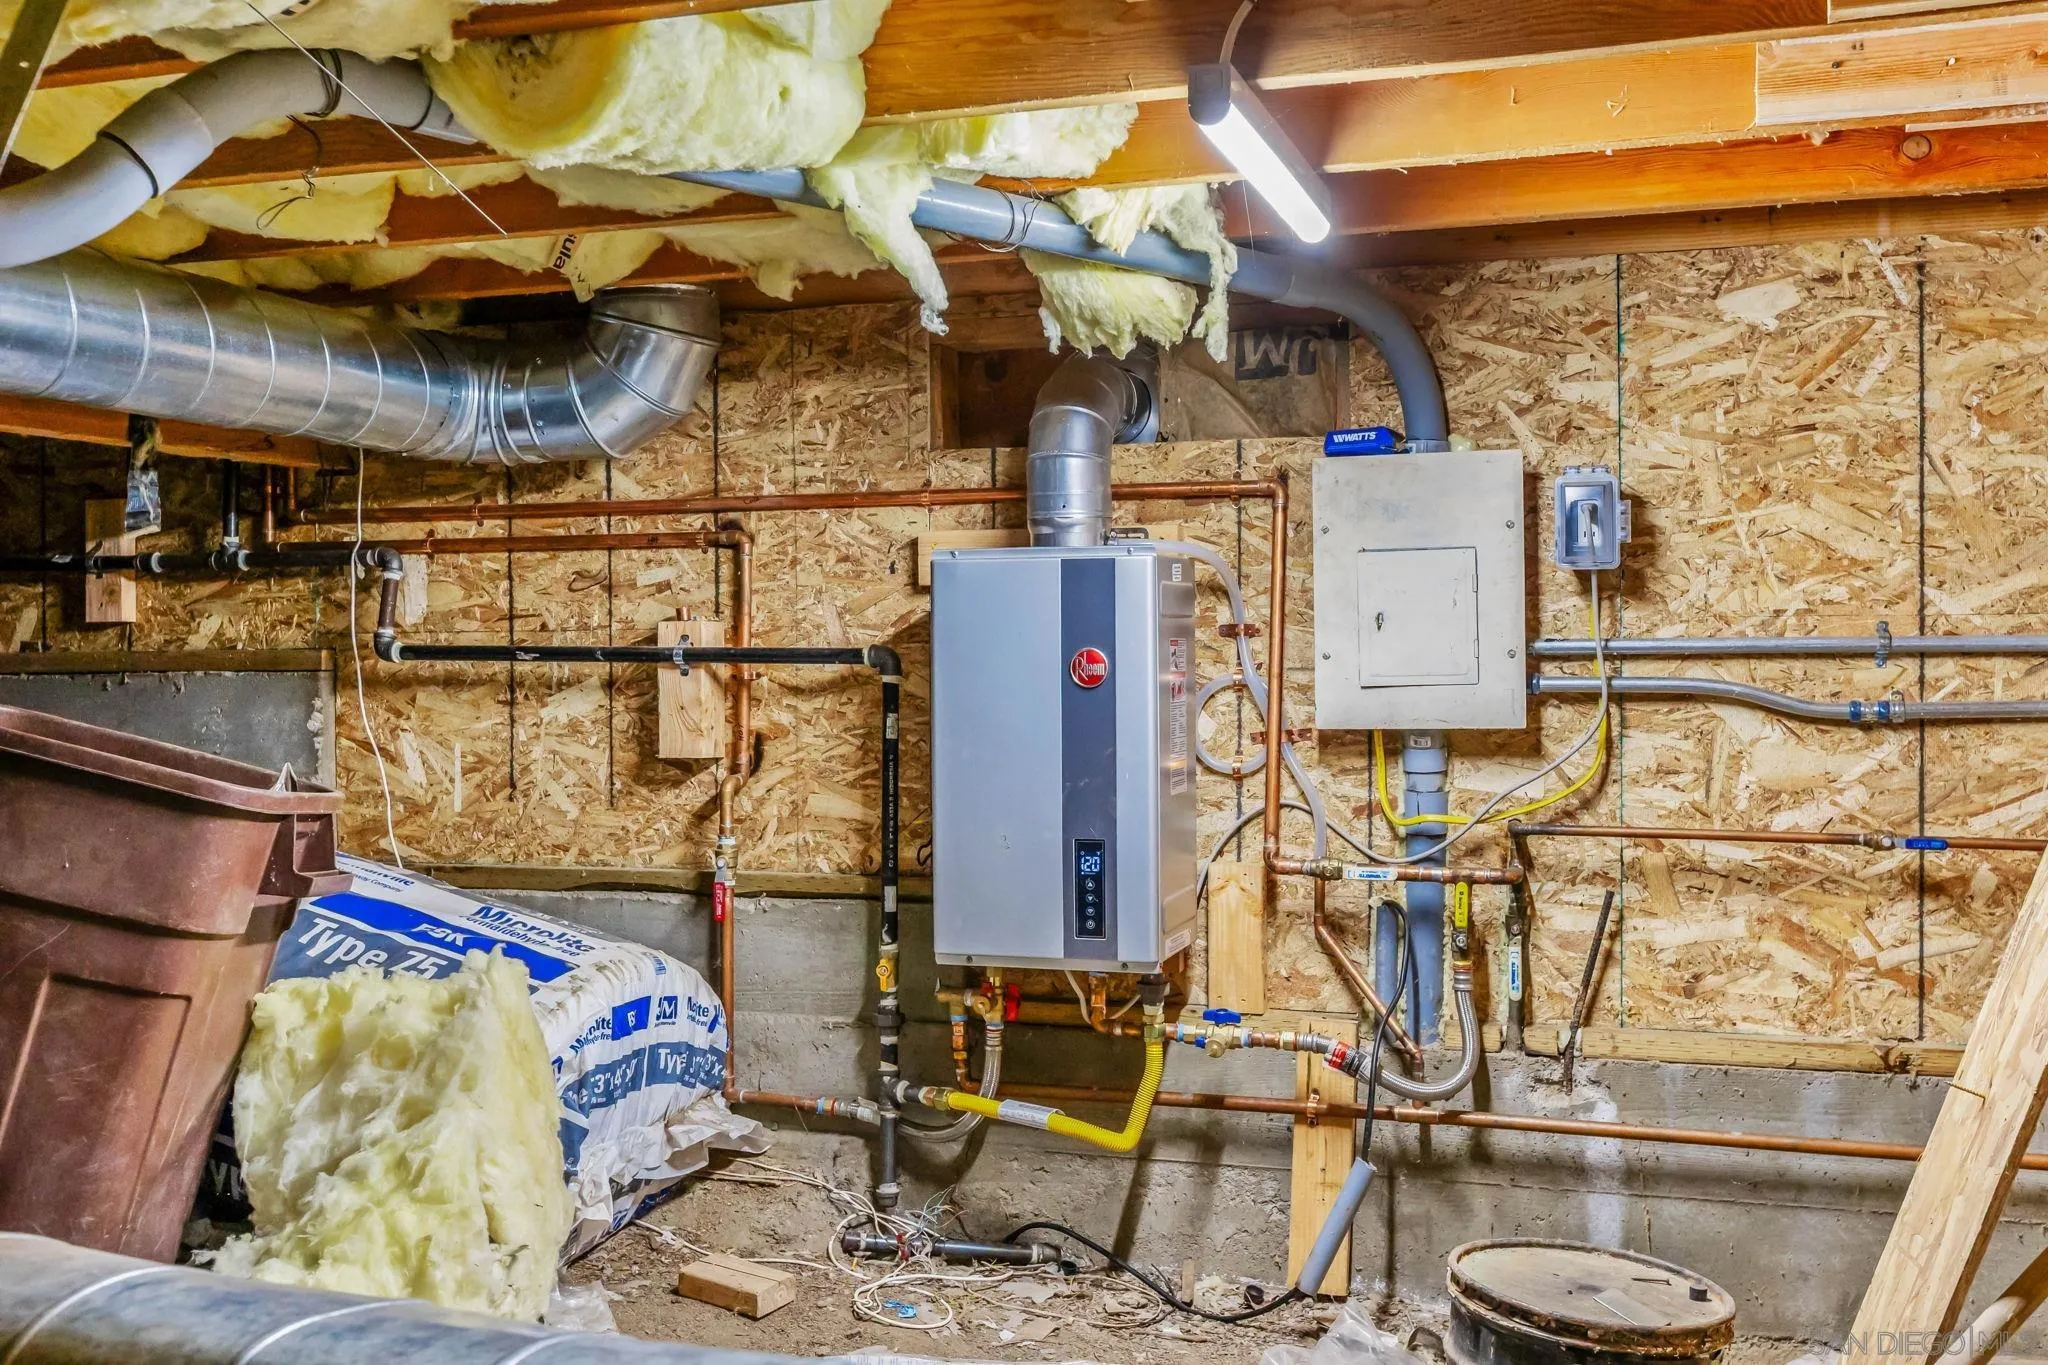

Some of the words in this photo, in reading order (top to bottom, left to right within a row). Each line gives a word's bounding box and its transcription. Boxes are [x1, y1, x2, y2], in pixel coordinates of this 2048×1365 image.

[1333, 431, 1377, 443] WATTS
[1075, 651, 1105, 681] Rheem
[1080, 856, 1100, 872] 120
[411, 923, 472, 947] FSK
[471, 904, 597, 952] Microlite
[298, 917, 389, 969] Type
